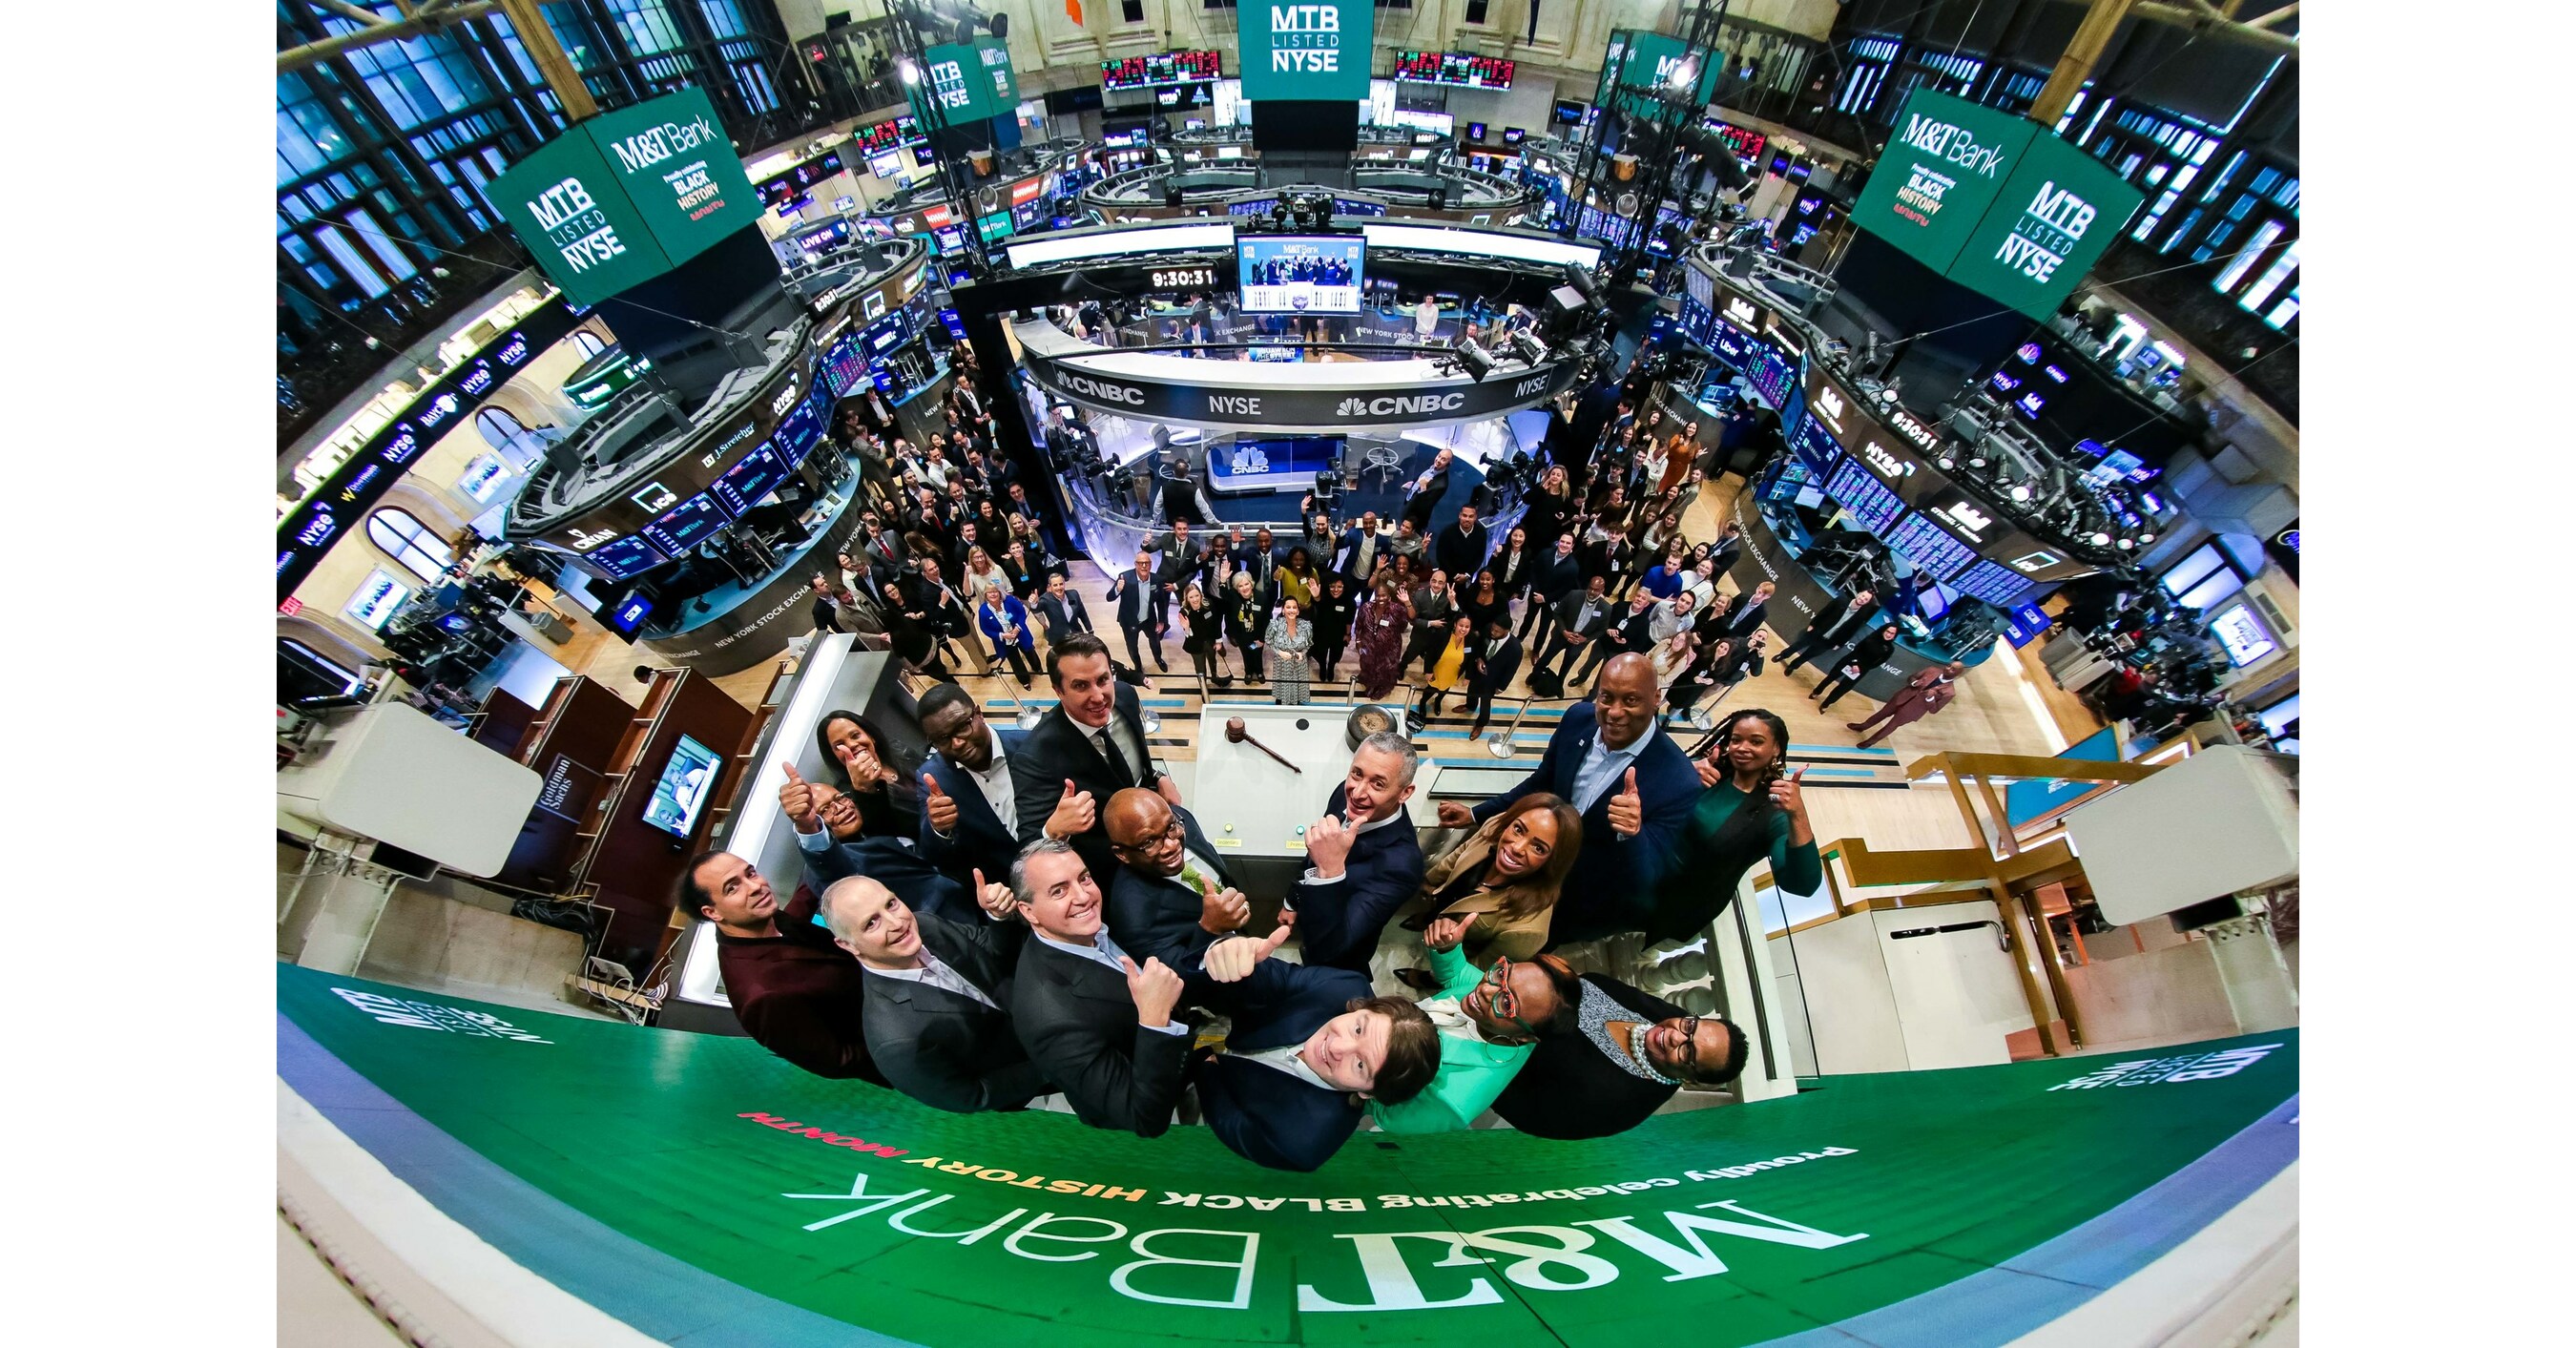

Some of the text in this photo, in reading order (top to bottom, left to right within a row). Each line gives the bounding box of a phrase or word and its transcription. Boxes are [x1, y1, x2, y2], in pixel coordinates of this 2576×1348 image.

[1271, 5, 1340, 32] MTB
[1271, 34, 1340, 48] LISTED
[1271, 49, 1340, 73] NYSE
[611, 114, 717, 175] M&T Bank
[1900, 113, 2005, 179] M&T Bank
[673, 169, 711, 196] BLACK
[676, 181, 719, 211] HISTORY
[1907, 173, 1947, 201] BLACK
[527, 176, 595, 232] MTB
[1896, 186, 1943, 216] HISTORY
[2025, 179, 2097, 240] MTB
[549, 209, 607, 248] LISTED
[800, 229, 834, 249] LIVE ON
[2015, 216, 2073, 256] LISTED
[560, 224, 627, 275] NYSE
[1283, 244, 1319, 254] M&T Bank
[1994, 232, 2065, 284] NYSE
[1153, 270, 1213, 287] 9:30:31
[1222, 324, 1255, 335] EXCHANGE
[1374, 329, 1392, 338] YORK
[1720, 338, 1739, 357] Uber
[1072, 377, 1145, 405] CNBC
[1514, 375, 1549, 399] NYSE
[924, 404, 938, 418] NEW
[1209, 396, 1261, 415] NYSE
[1369, 393, 1465, 414] CNBC
[1892, 412, 1938, 450] 9:30:31
[1232, 466, 1270, 474] CNBC
[1930, 507, 1956, 526] CITADEL
[1739, 524, 1752, 547] STOCK
[1750, 544, 1779, 581] EXCHANGE
[1791, 595, 1811, 613] NEW
[715, 636, 734, 649] NEW
[735, 624, 758, 640] YORK
[757, 605, 786, 626] STOCK
[540, 759, 571, 806] Goldman
[549, 778, 571, 810] Sachs
[330, 987, 445, 1030] MTB
[2166, 1043, 2283, 1082] MTB
[737, 1111, 1859, 1213] Proudly celebrating BLACK HISTORY MONTH
[780, 1172, 1870, 1313] M&T Bank
